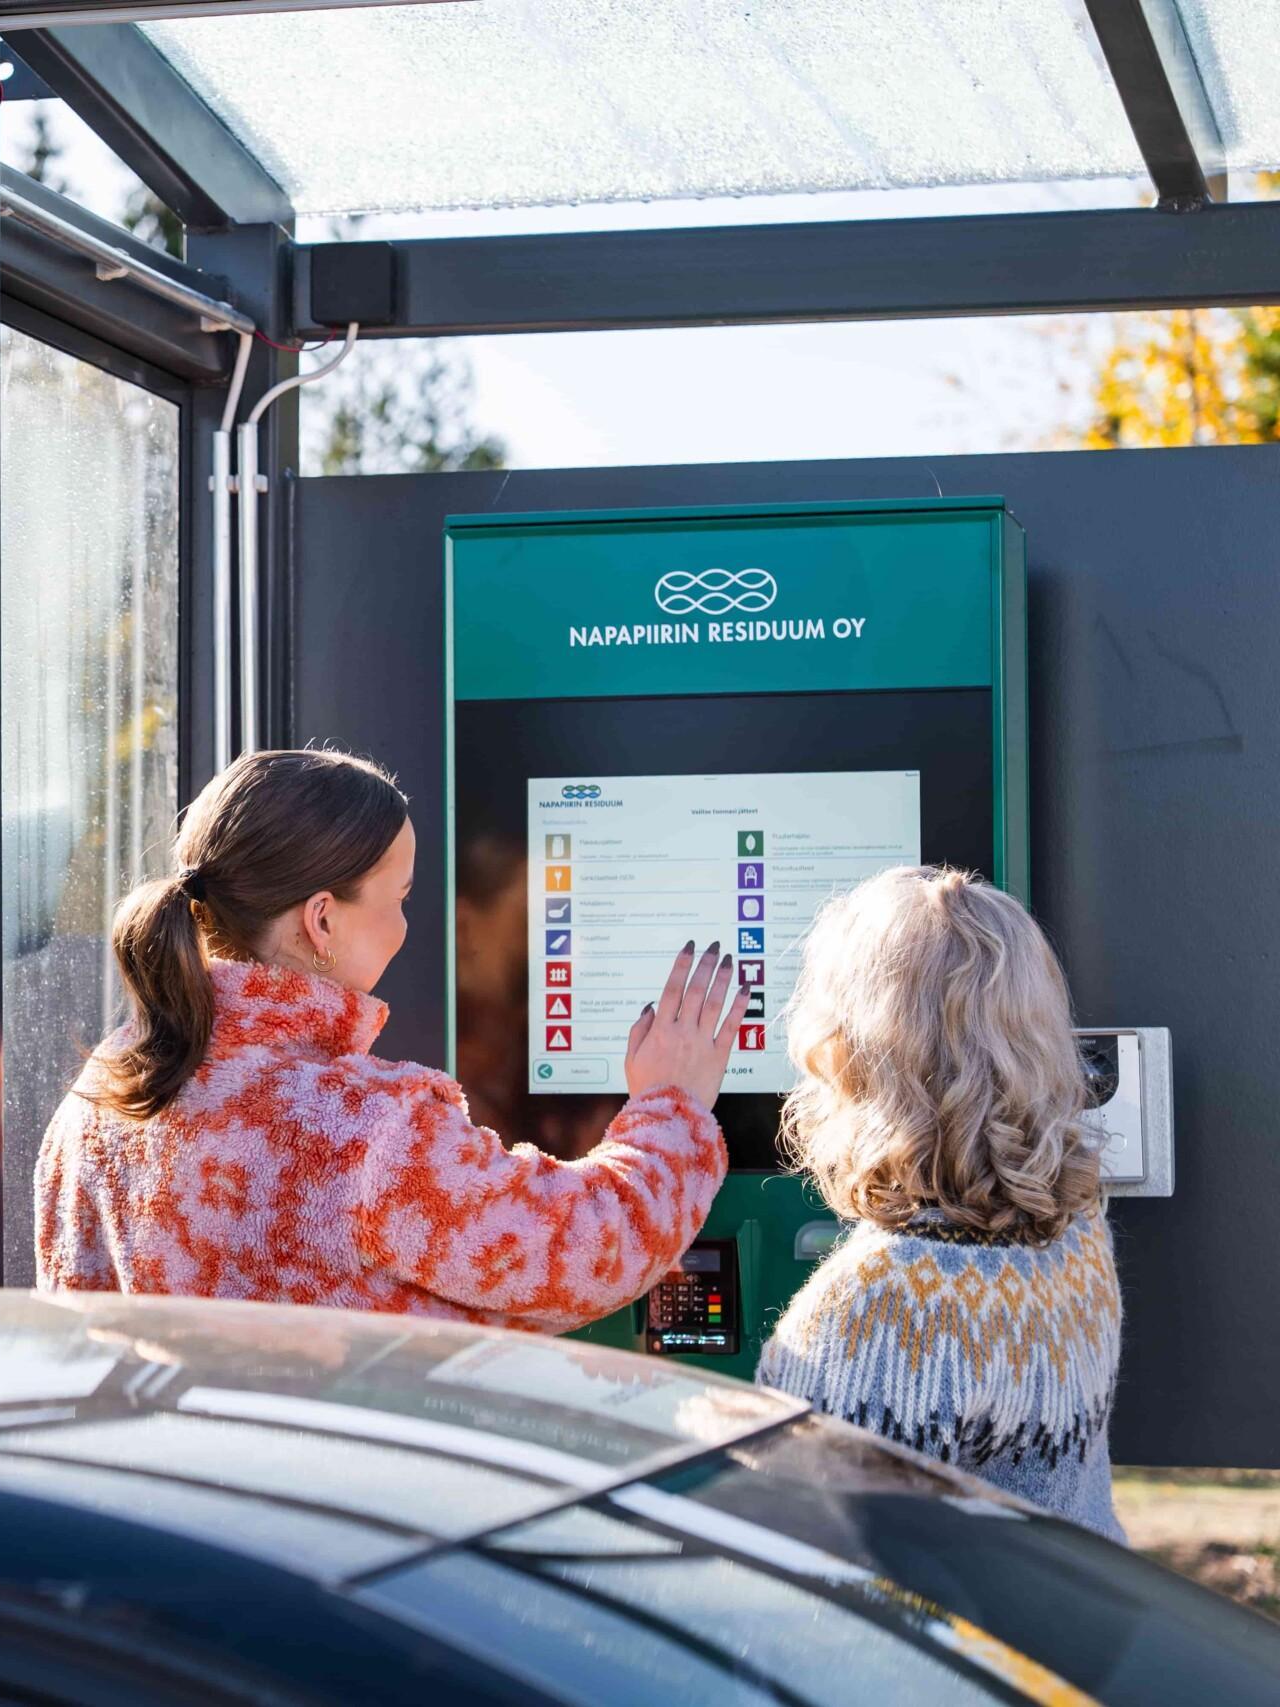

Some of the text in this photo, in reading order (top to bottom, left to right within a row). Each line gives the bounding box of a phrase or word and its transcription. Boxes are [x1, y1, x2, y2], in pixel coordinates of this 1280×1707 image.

[570, 617, 866, 647] NAPAPIIRIN RESIDUUM OY
[584, 799, 623, 808] RESIDUUM
